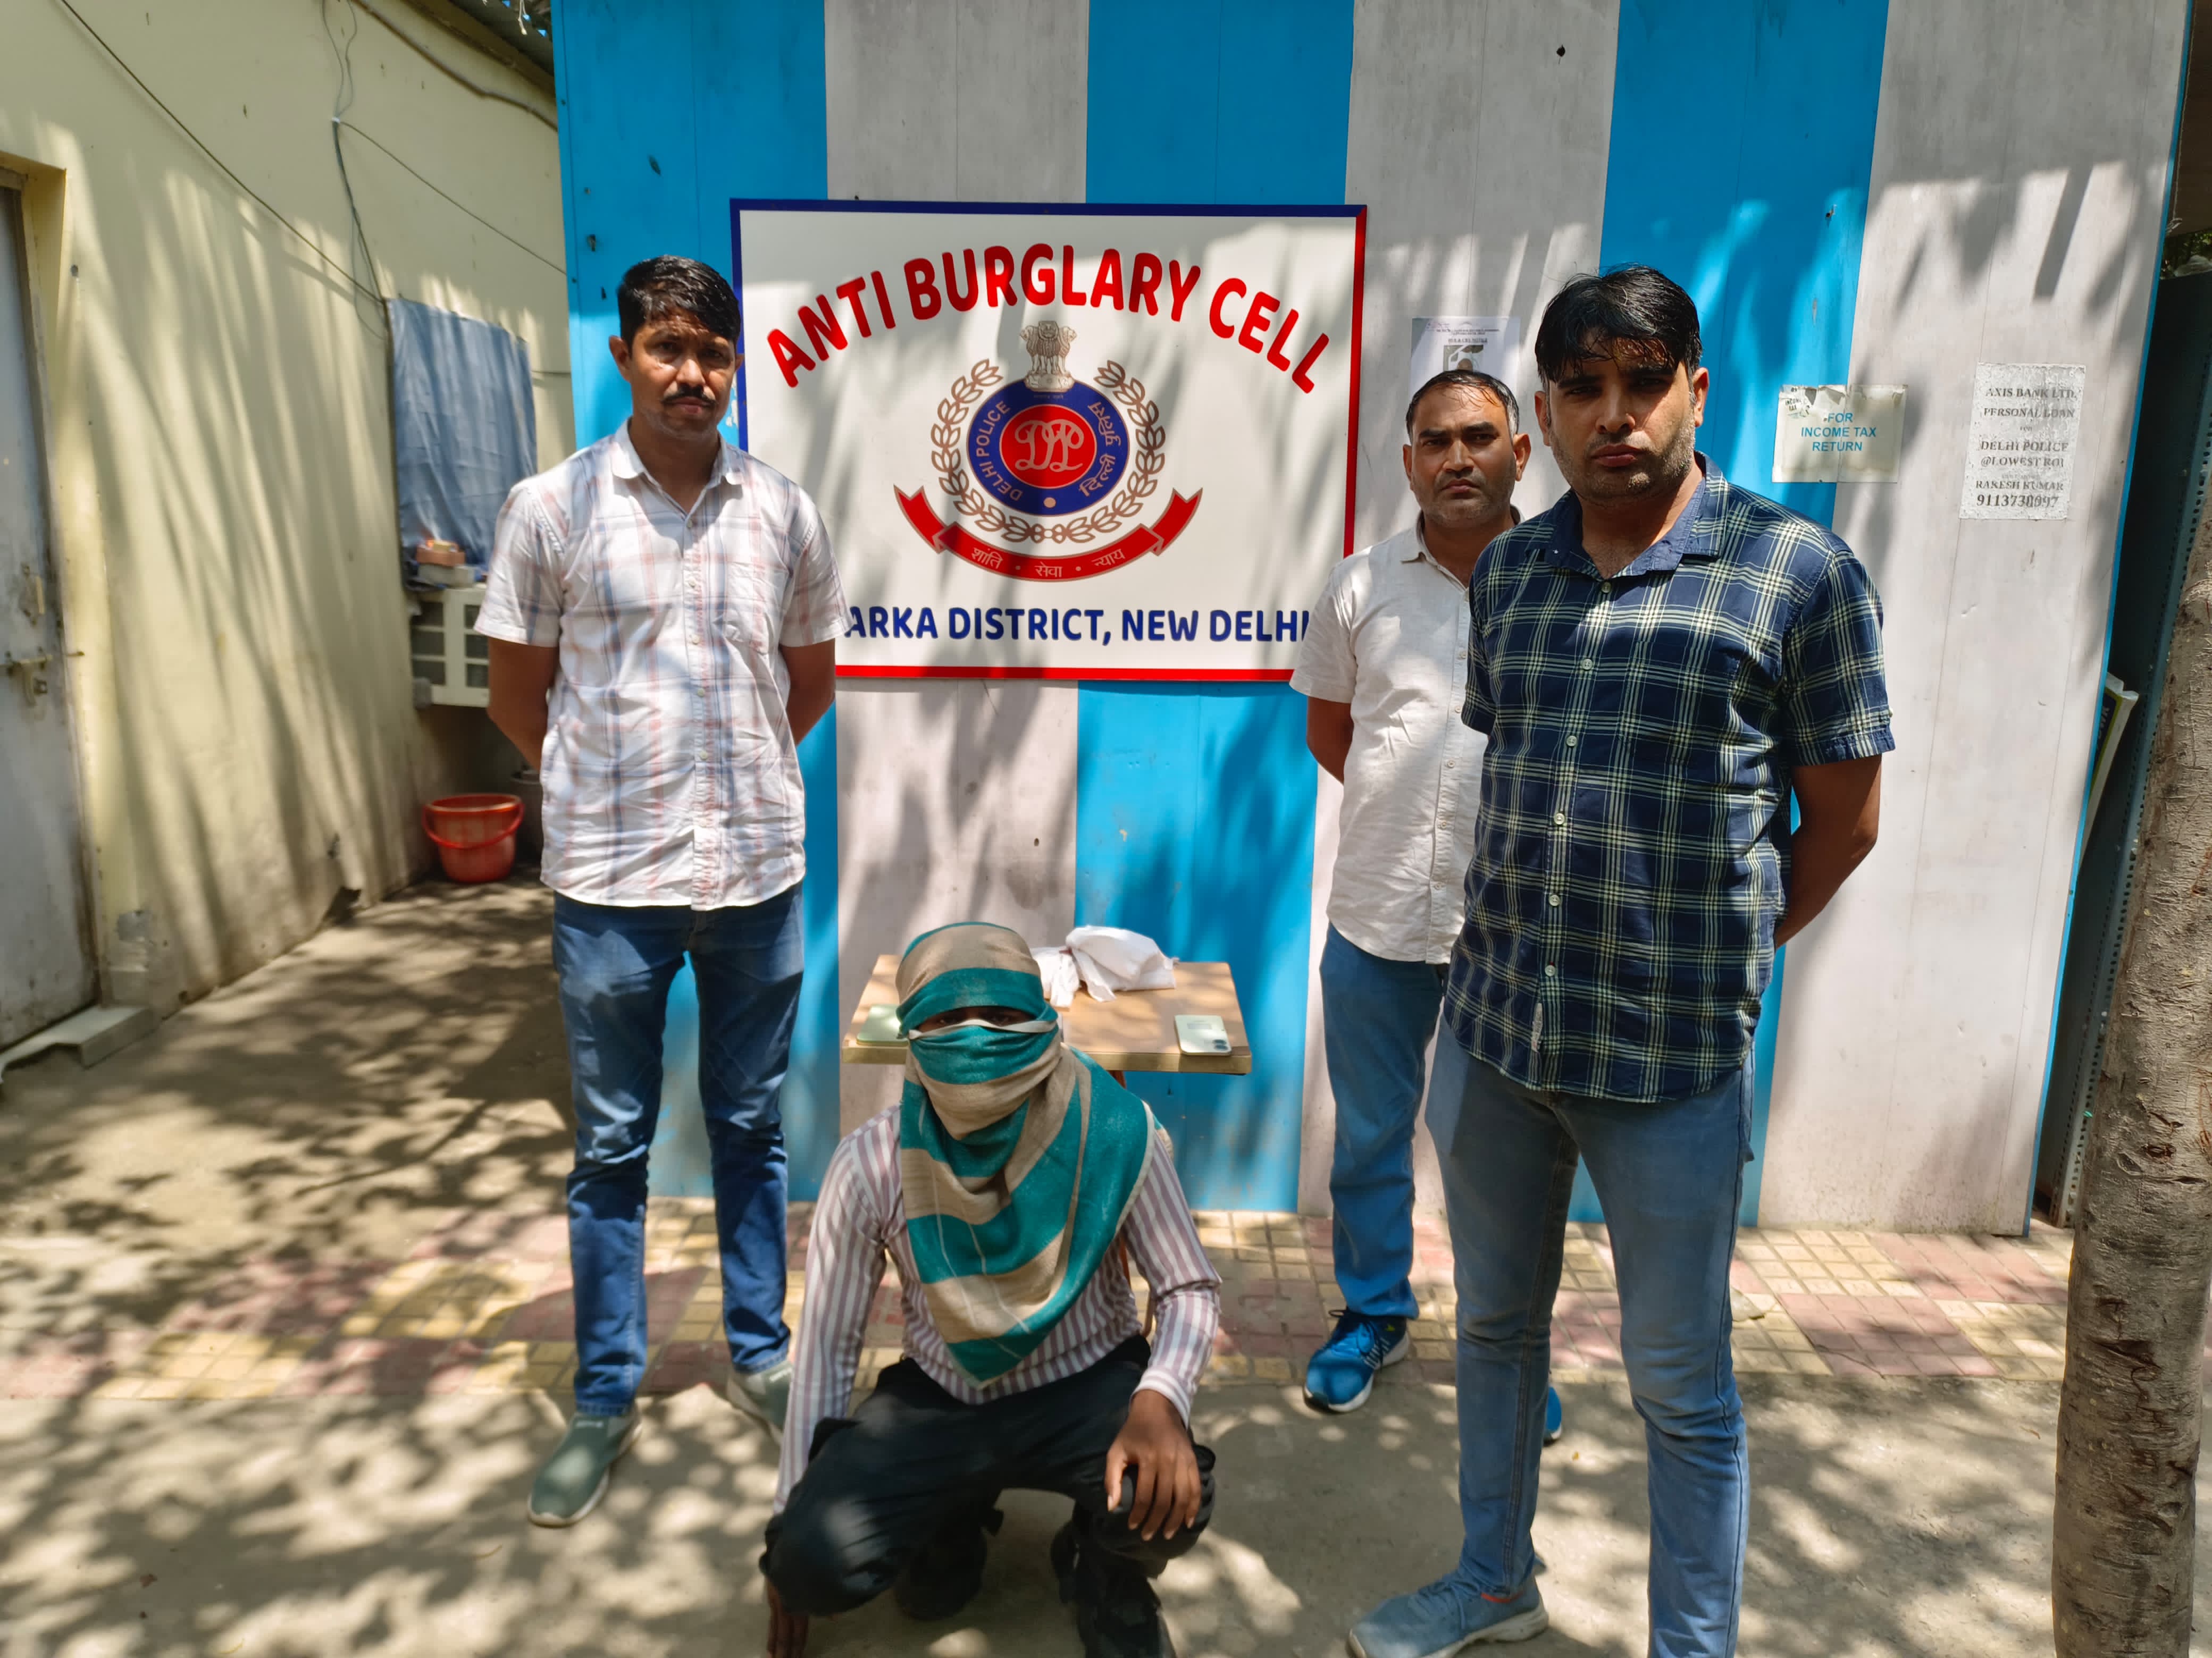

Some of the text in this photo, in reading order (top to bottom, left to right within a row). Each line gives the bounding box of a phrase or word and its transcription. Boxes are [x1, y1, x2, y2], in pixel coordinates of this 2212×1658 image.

[767, 243, 1329, 394] ANTI BURGLARY CELL
[2016, 388, 2050, 398] BANK
[1828, 413, 1854, 423] FOR
[1801, 427, 1876, 437] INCOME TAX
[976, 401, 1023, 501] DELHI POLICE
[1078, 401, 1121, 497] दिल्ली पुलिस
[1812, 441, 1863, 452] RETURN
[1981, 441, 2019, 451] DELHI
[971, 548, 1126, 578] शांति सेवा न्याय
[844, 606, 938, 638] ARKA
[948, 608, 1111, 646] DISTRICT,
[1122, 609, 1199, 642] NEW
